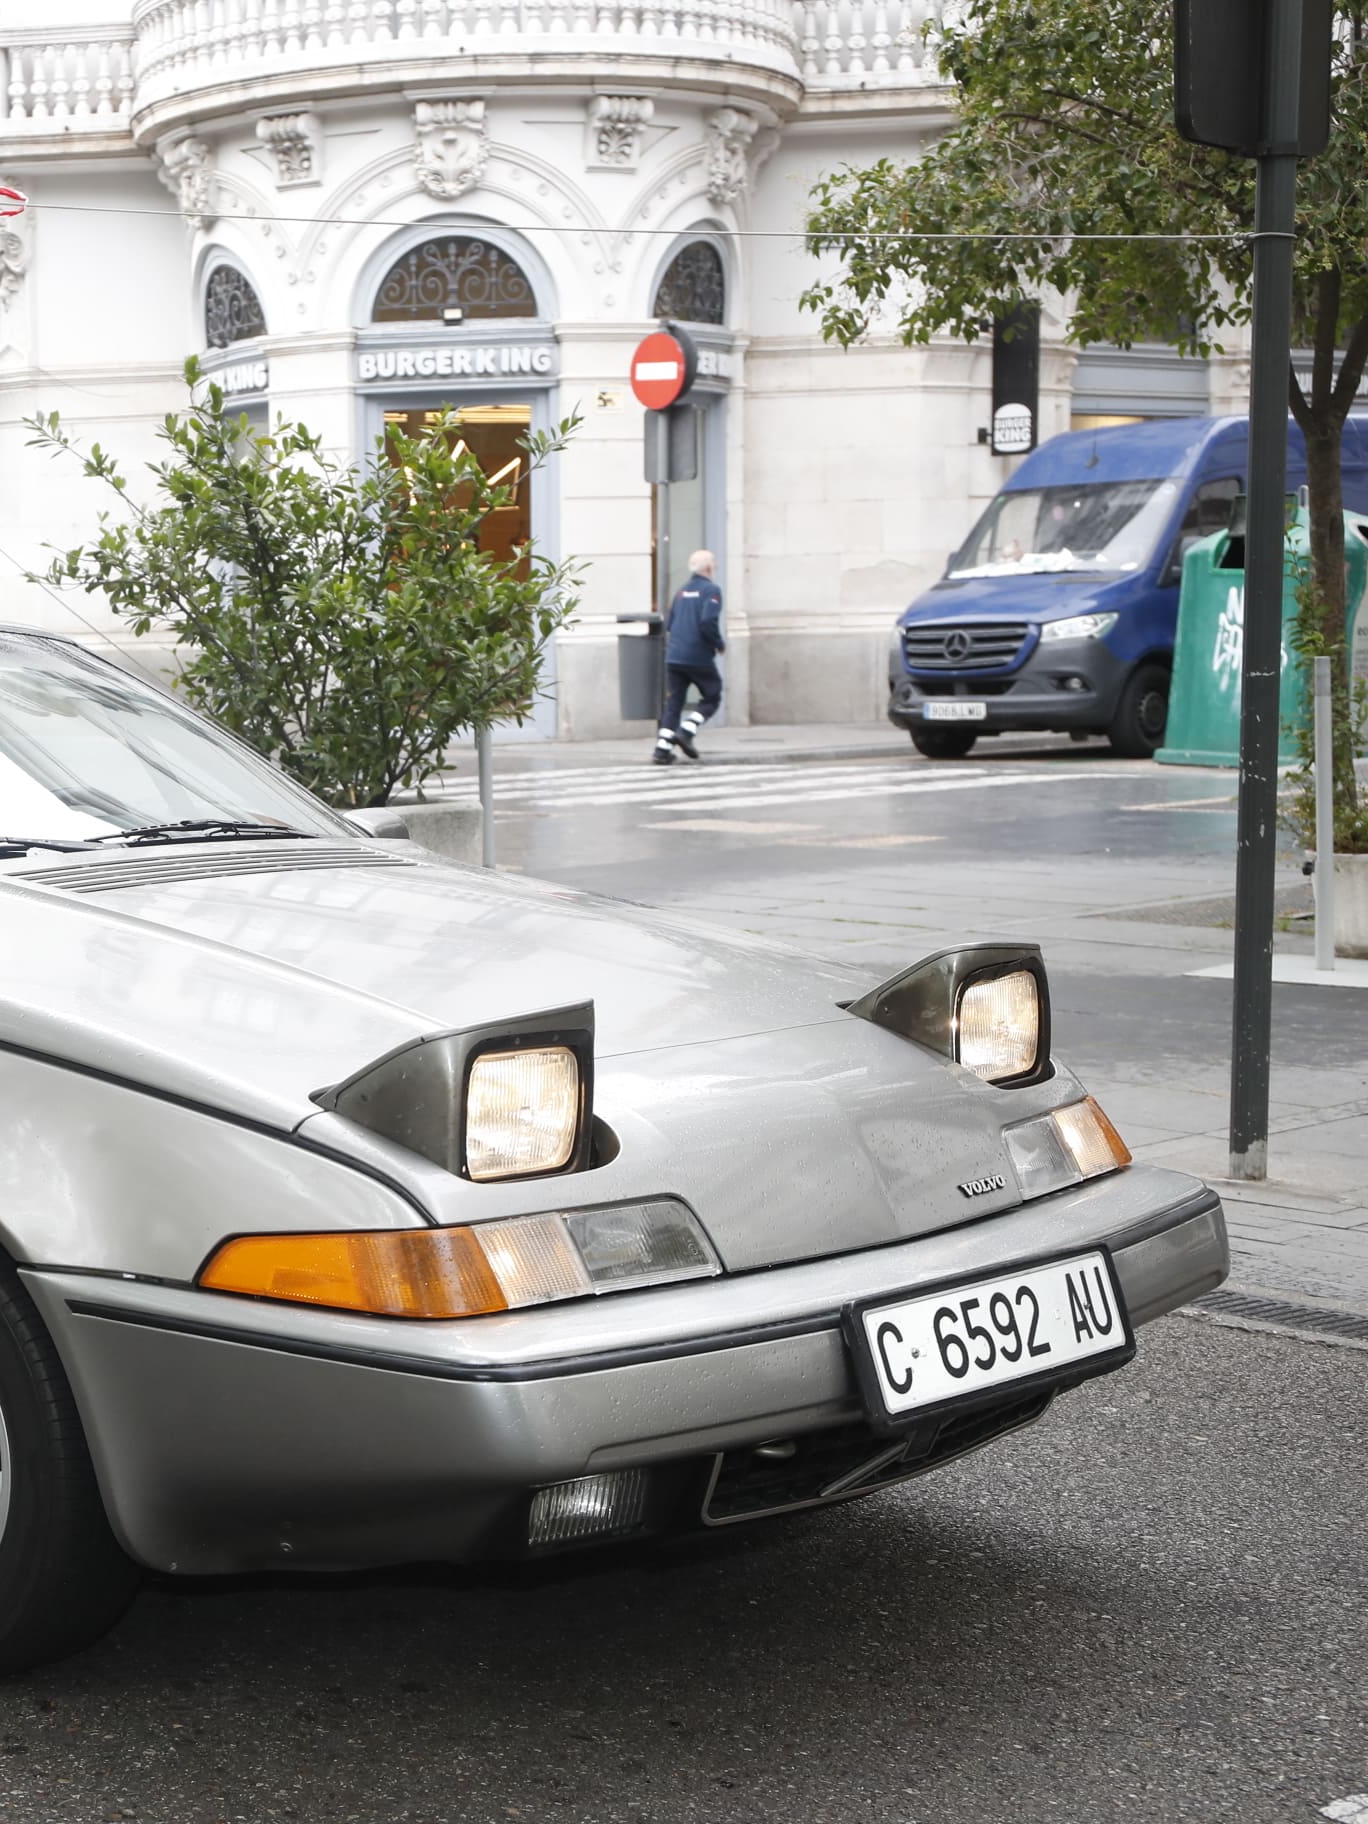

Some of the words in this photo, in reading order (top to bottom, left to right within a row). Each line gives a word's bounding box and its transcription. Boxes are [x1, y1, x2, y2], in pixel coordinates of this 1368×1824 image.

[358, 349, 473, 379] BURGER
[475, 346, 553, 374] KING
[226, 363, 268, 392] KING
[994, 427, 1031, 443] KING
[958, 1174, 1006, 1197] VOLVO
[877, 1321, 913, 1395] C
[933, 1285, 1051, 1379] 6592
[1065, 1265, 1113, 1344] AU
